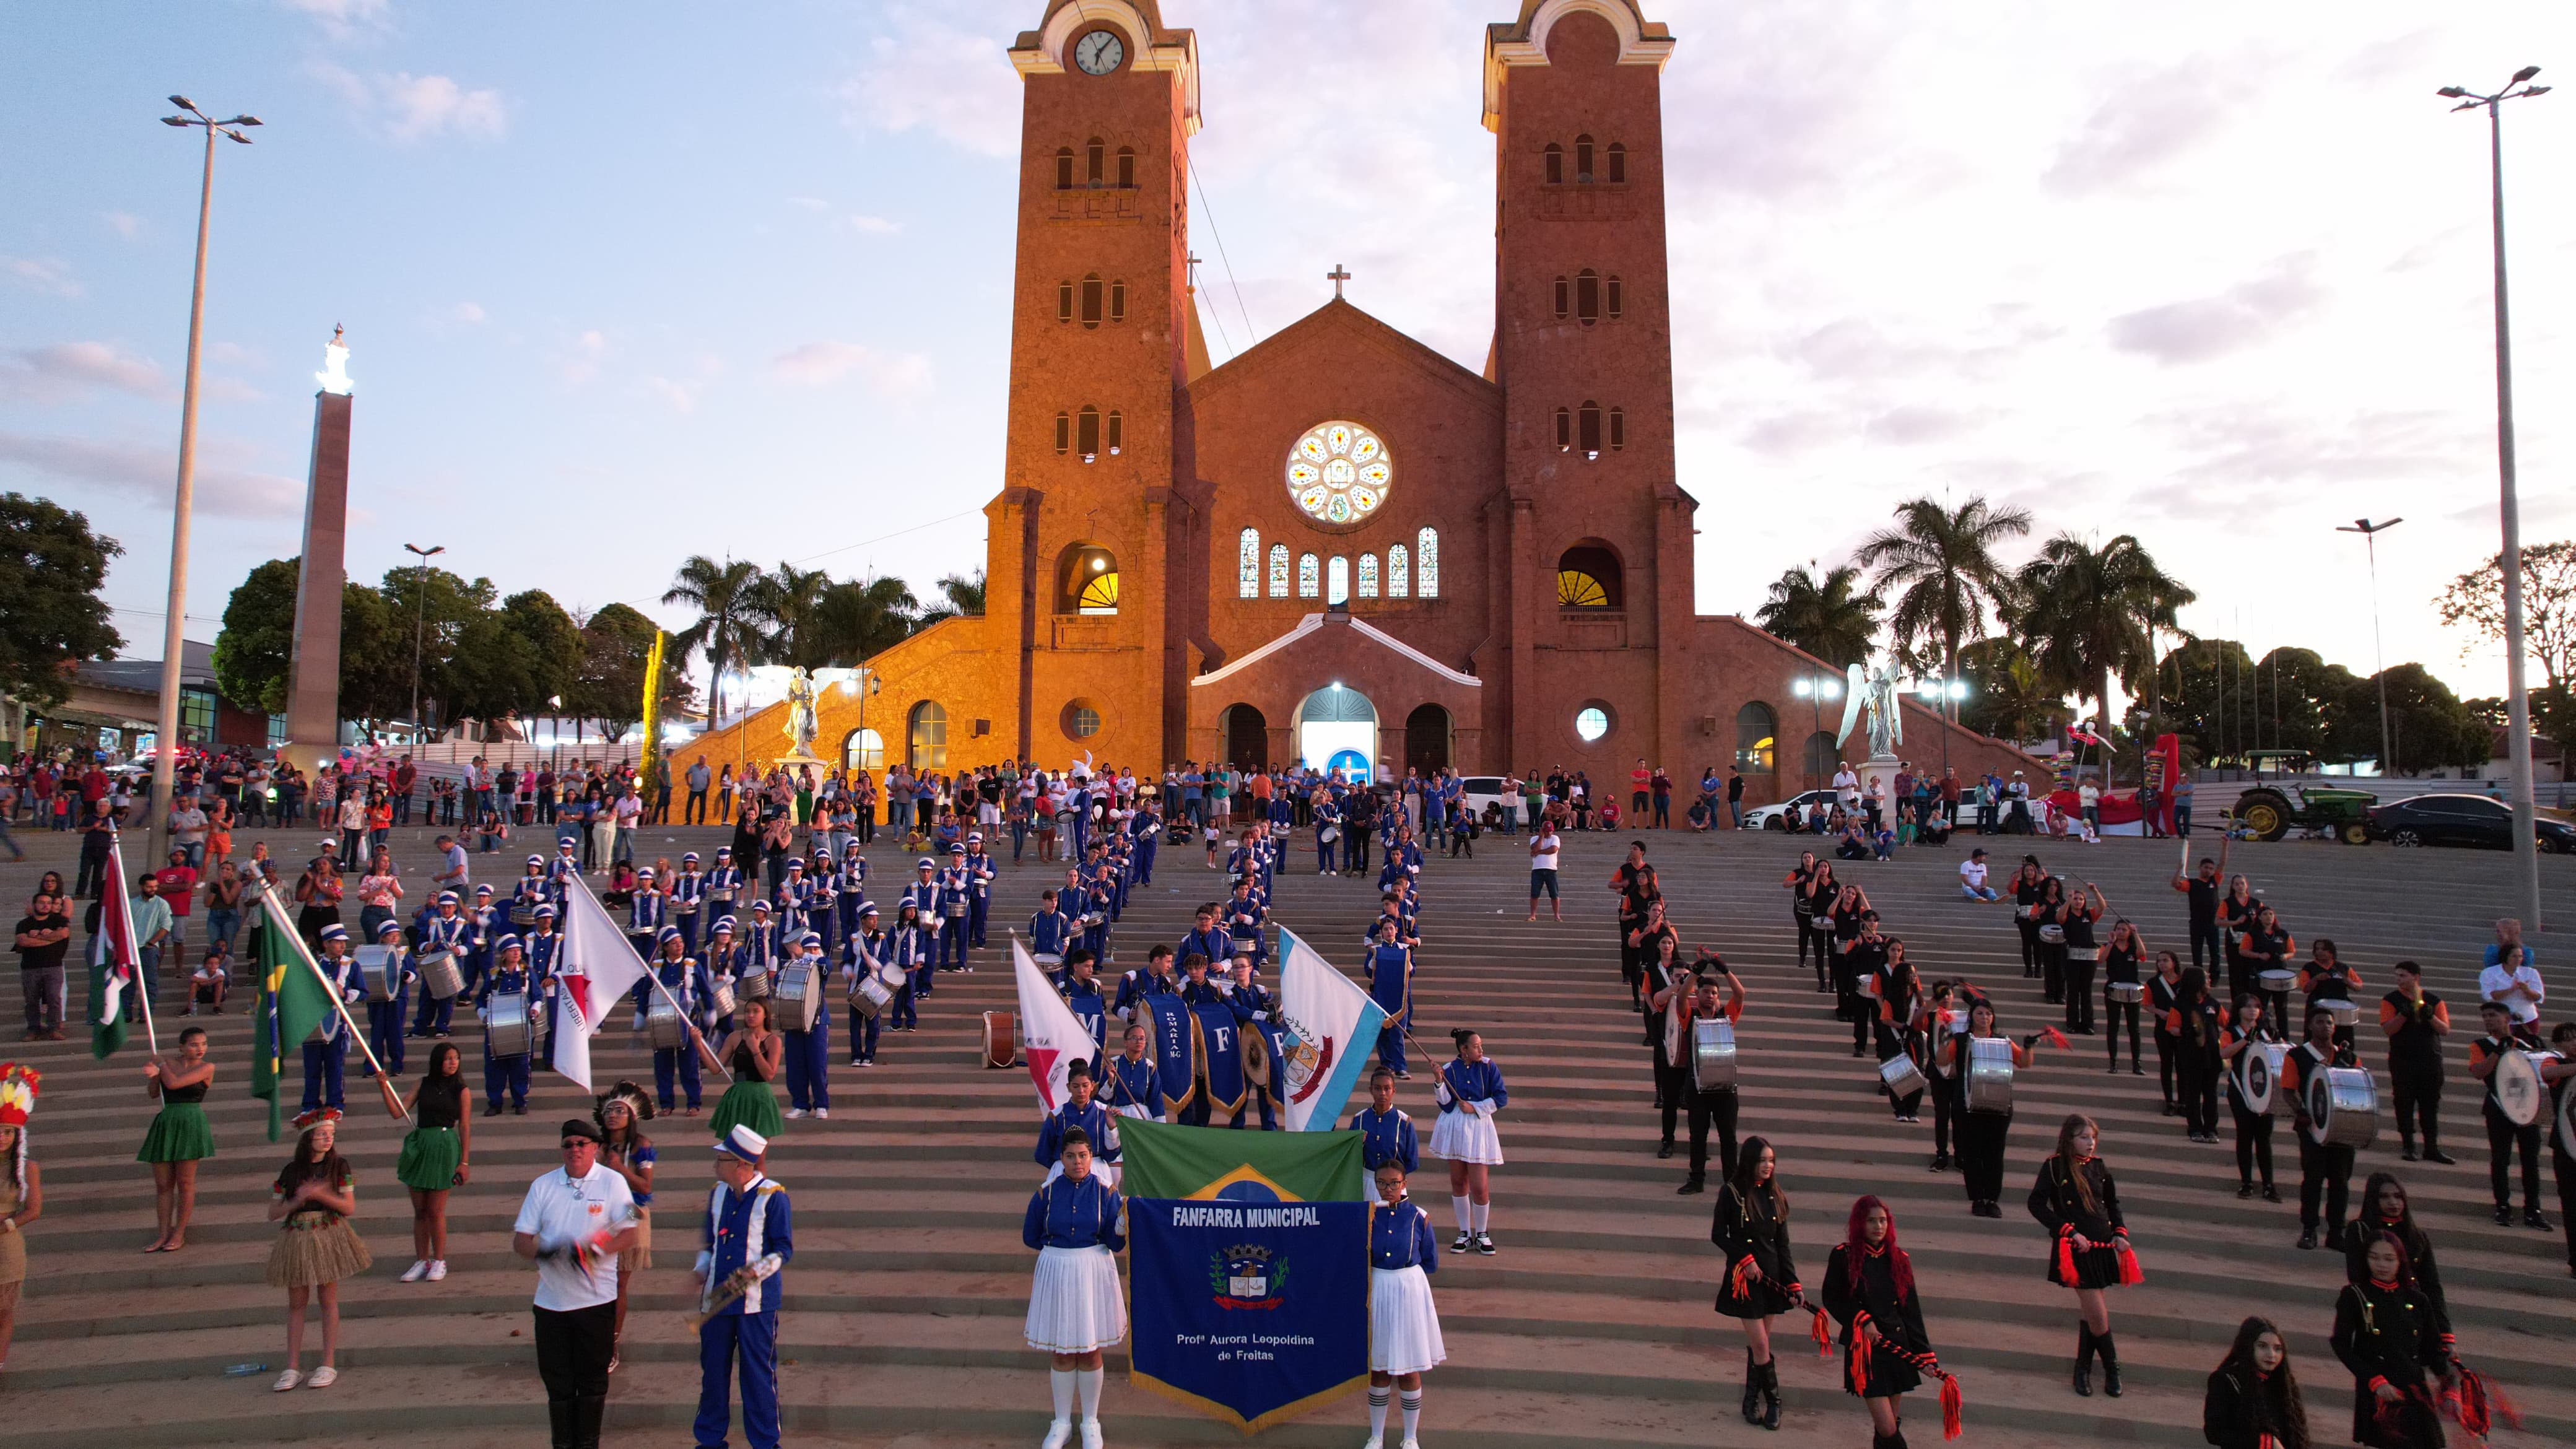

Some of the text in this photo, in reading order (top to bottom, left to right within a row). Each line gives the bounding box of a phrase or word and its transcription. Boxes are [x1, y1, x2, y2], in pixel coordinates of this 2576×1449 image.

[560, 988, 585, 1032] LIBERTAS
[1076, 1013, 1100, 1038] M
[1165, 1012, 1178, 1050] ROMARIA
[1214, 1026, 1230, 1053] F
[1173, 1206, 1320, 1228] FANFARRA MUNICIPAL
[1210, 1334, 1247, 1344] Aurora
[1253, 1333, 1315, 1347] Leopoldina
[1218, 1350, 1274, 1361] de Freitas
